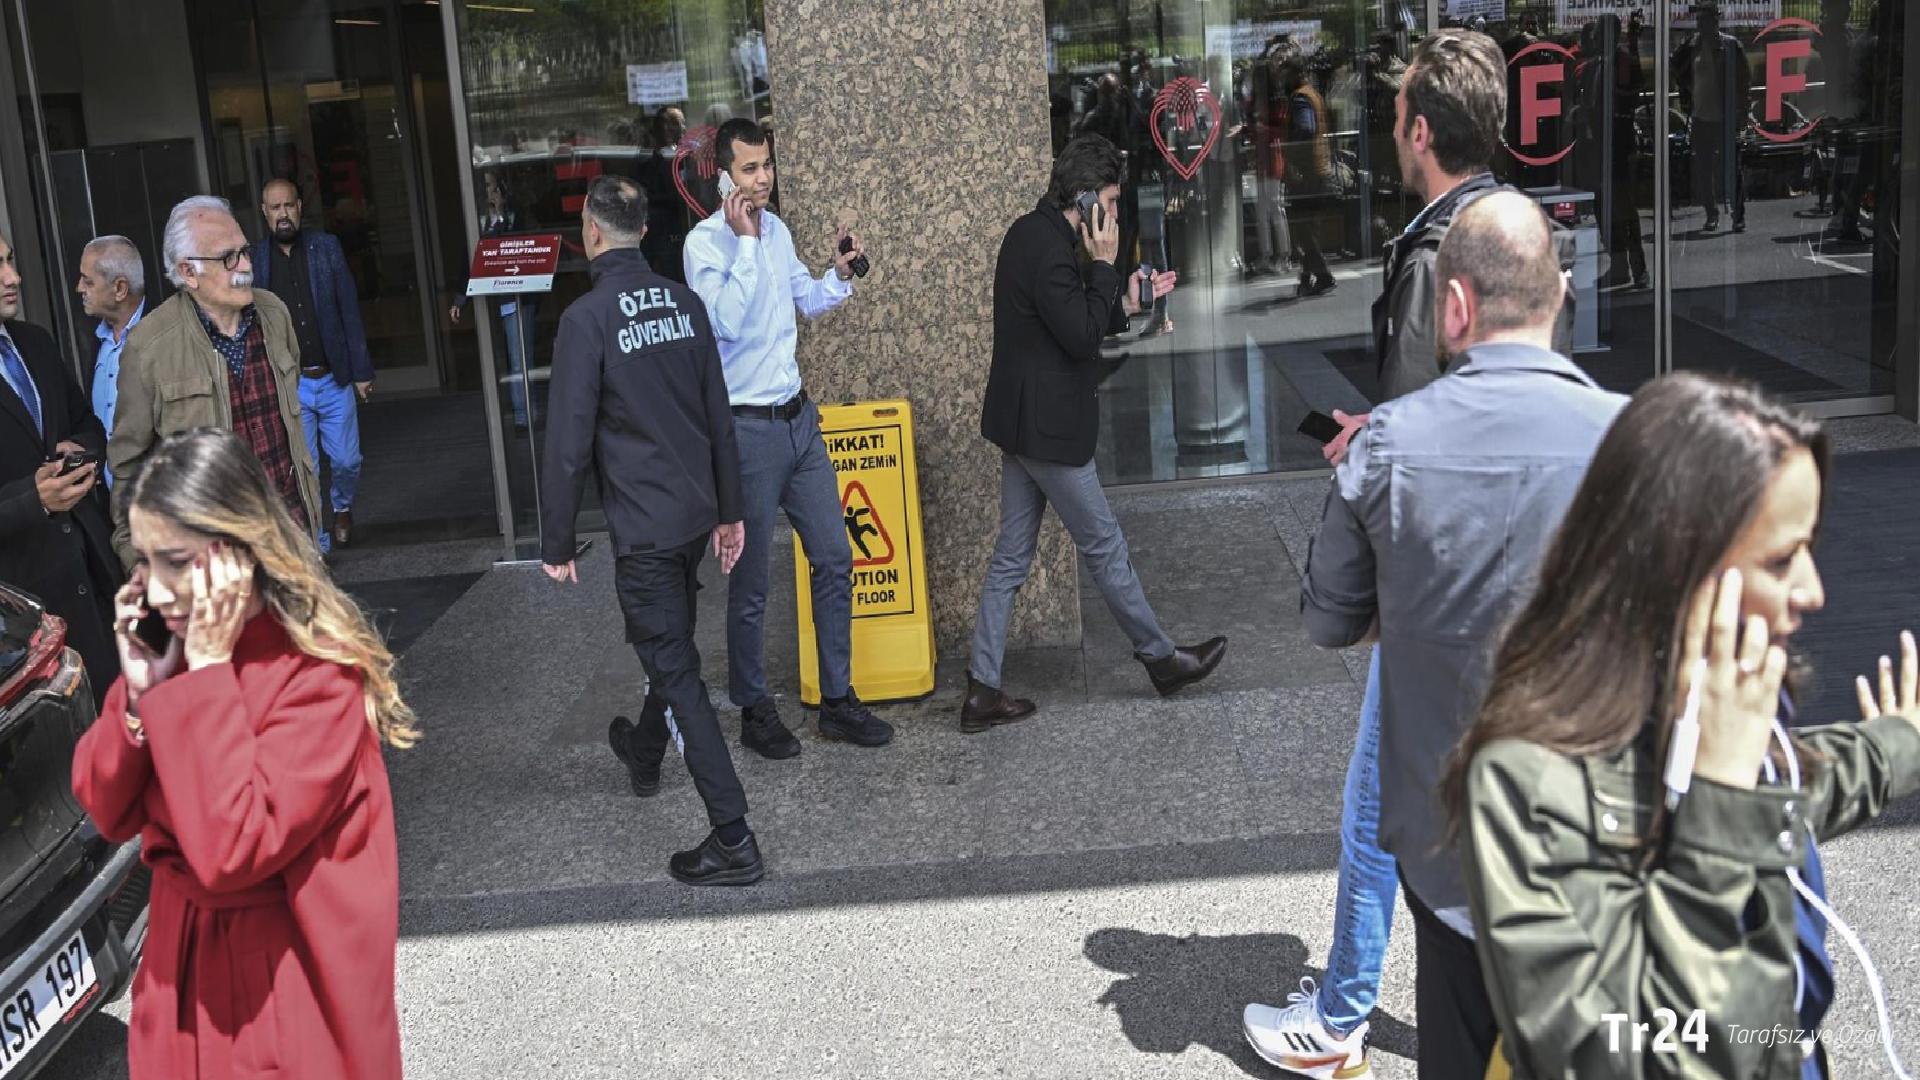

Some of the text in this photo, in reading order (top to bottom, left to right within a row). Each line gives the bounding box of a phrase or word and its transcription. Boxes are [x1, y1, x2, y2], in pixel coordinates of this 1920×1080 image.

[1765, 39, 1811, 122] F
[1520, 64, 1564, 145] F
[618, 287, 677, 317] ÖZEL
[618, 312, 695, 353] GÜVENLİK
[824, 434, 884, 453] İKKAT!
[832, 457, 857, 472] GAN
[852, 568, 898, 587] TION
[857, 589, 896, 606] FLOOR
[46, 936, 84, 1009] 197
